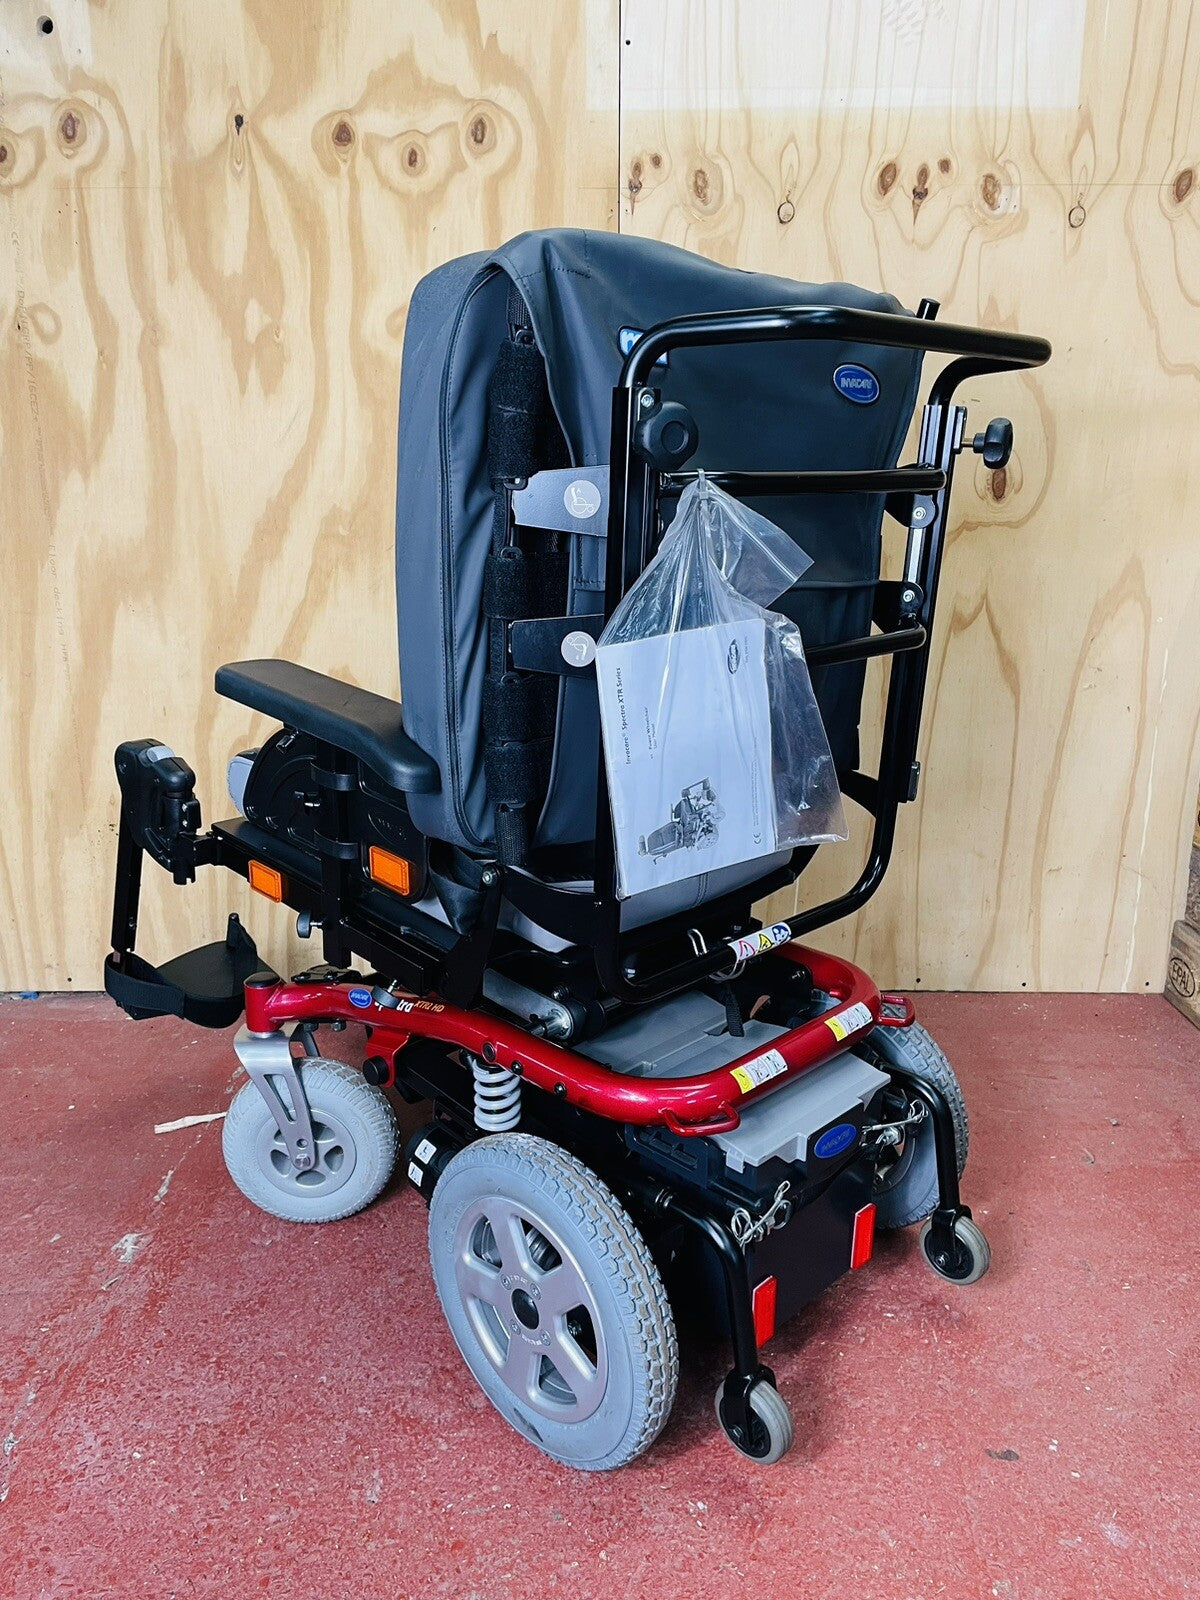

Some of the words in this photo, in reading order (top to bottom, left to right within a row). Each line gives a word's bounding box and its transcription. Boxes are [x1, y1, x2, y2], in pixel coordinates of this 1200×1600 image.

[840, 377, 872, 389] INVACARE
[1172, 961, 1190, 993] EPAL
[431, 1003, 445, 1013] HD
